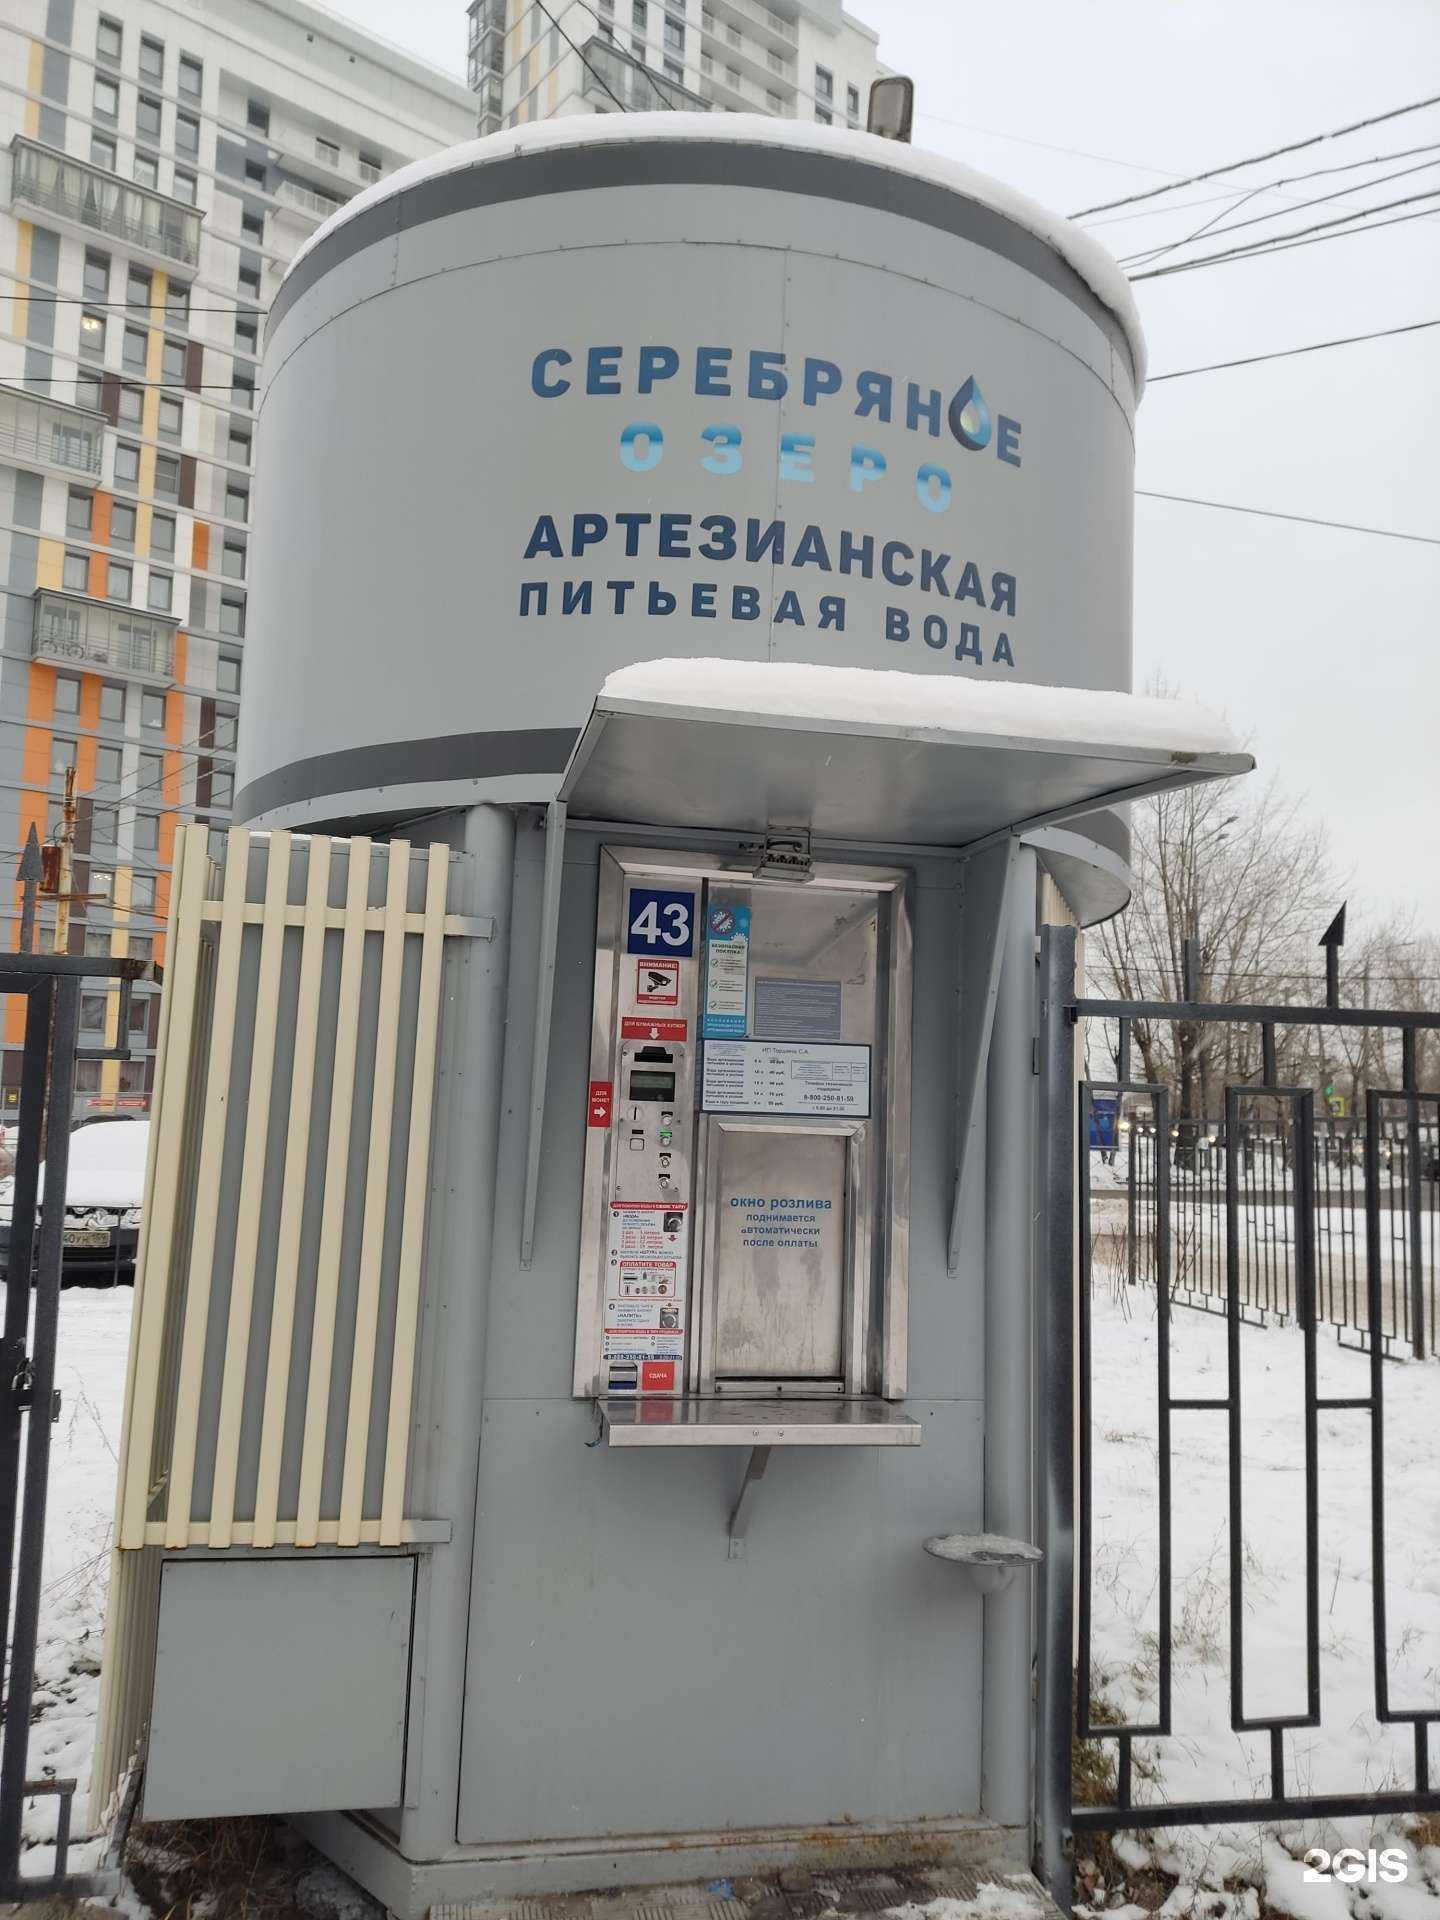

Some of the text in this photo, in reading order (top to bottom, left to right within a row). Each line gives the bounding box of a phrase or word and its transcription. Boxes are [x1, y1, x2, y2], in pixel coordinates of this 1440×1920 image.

[530, 345, 1022, 468] СЕРЕБРЯНОЕ
[619, 420, 952, 513] ОЗЕРО
[523, 513, 1017, 617] АРТЕЗИАНСКАЯ
[519, 580, 1015, 668] ПИТЬЕВАЯ ВОДА
[631, 901, 689, 946] 43
[731, 1198, 832, 1211] окно розлива
[746, 1214, 816, 1223] поднимается
[741, 1227, 820, 1235] автоматически
[778, 1240, 818, 1248] оплаты
